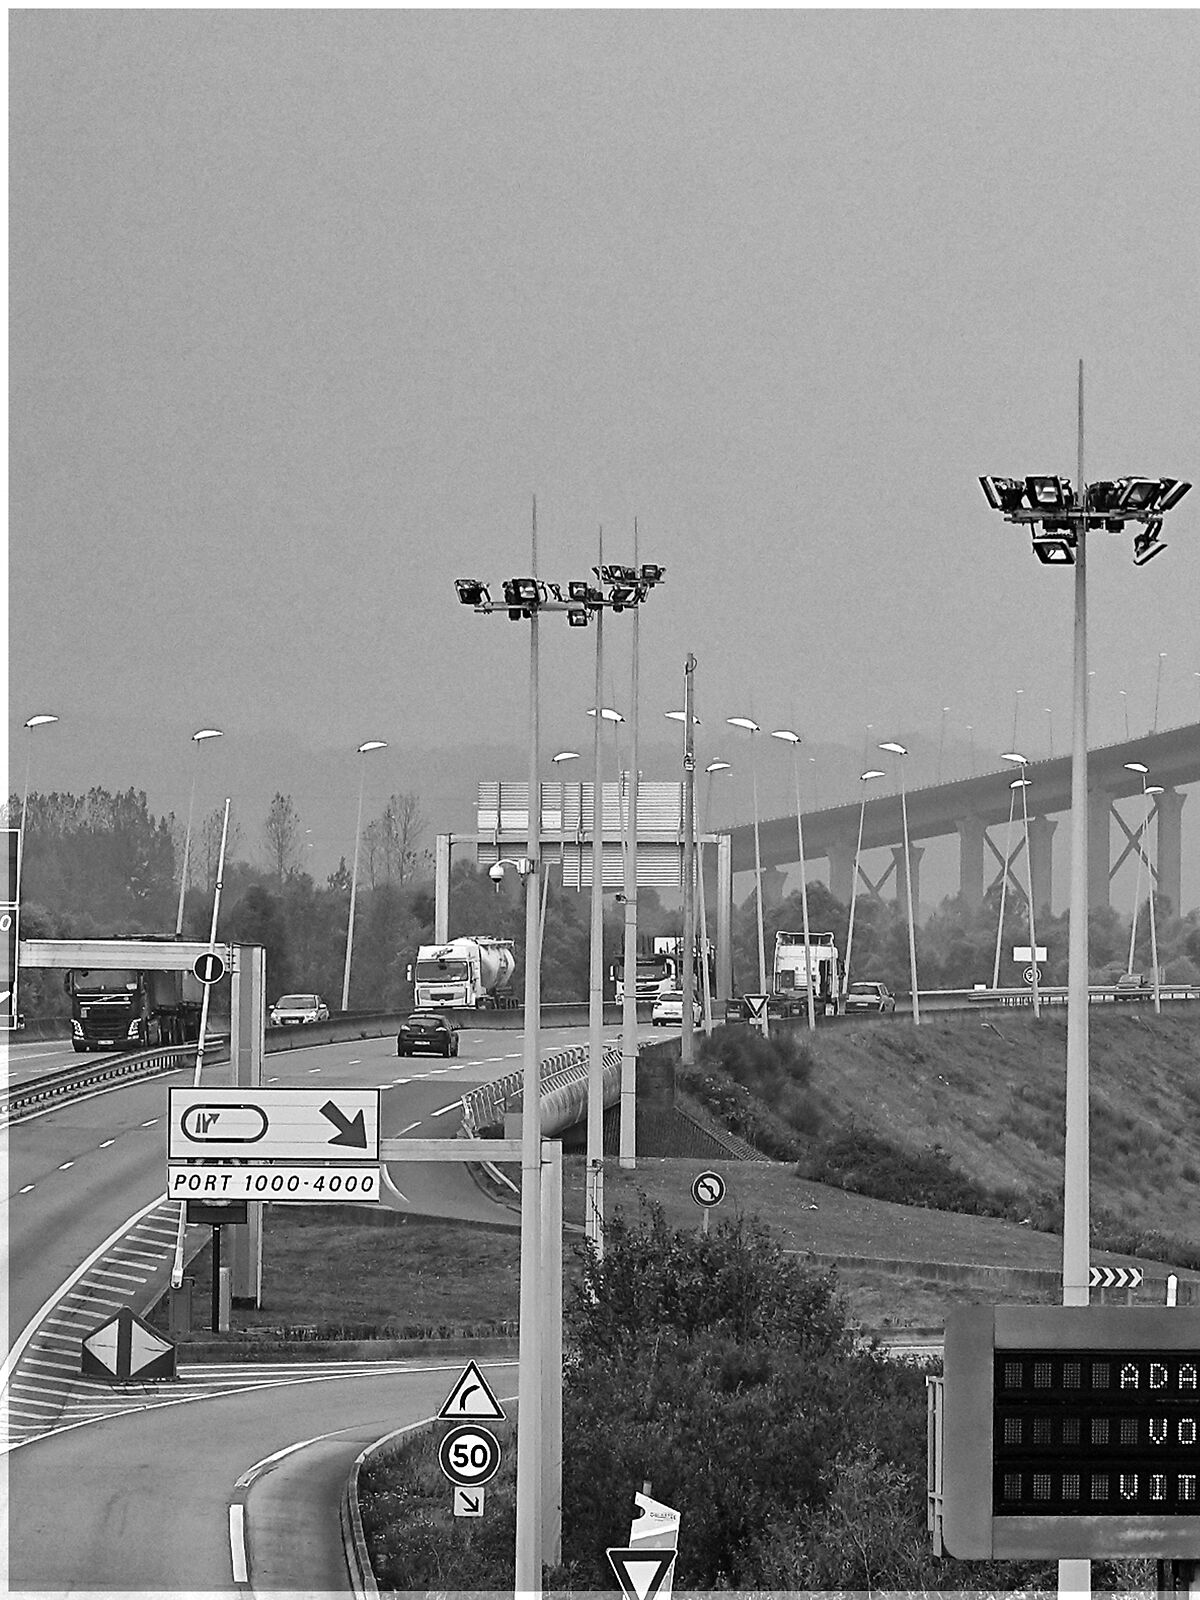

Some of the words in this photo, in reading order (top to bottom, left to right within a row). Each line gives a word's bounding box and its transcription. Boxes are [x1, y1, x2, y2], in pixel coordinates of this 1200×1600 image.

[174, 1174, 233, 1192] PORT
[245, 1175, 374, 1193] 1000-4000
[453, 1444, 488, 1468] 50
